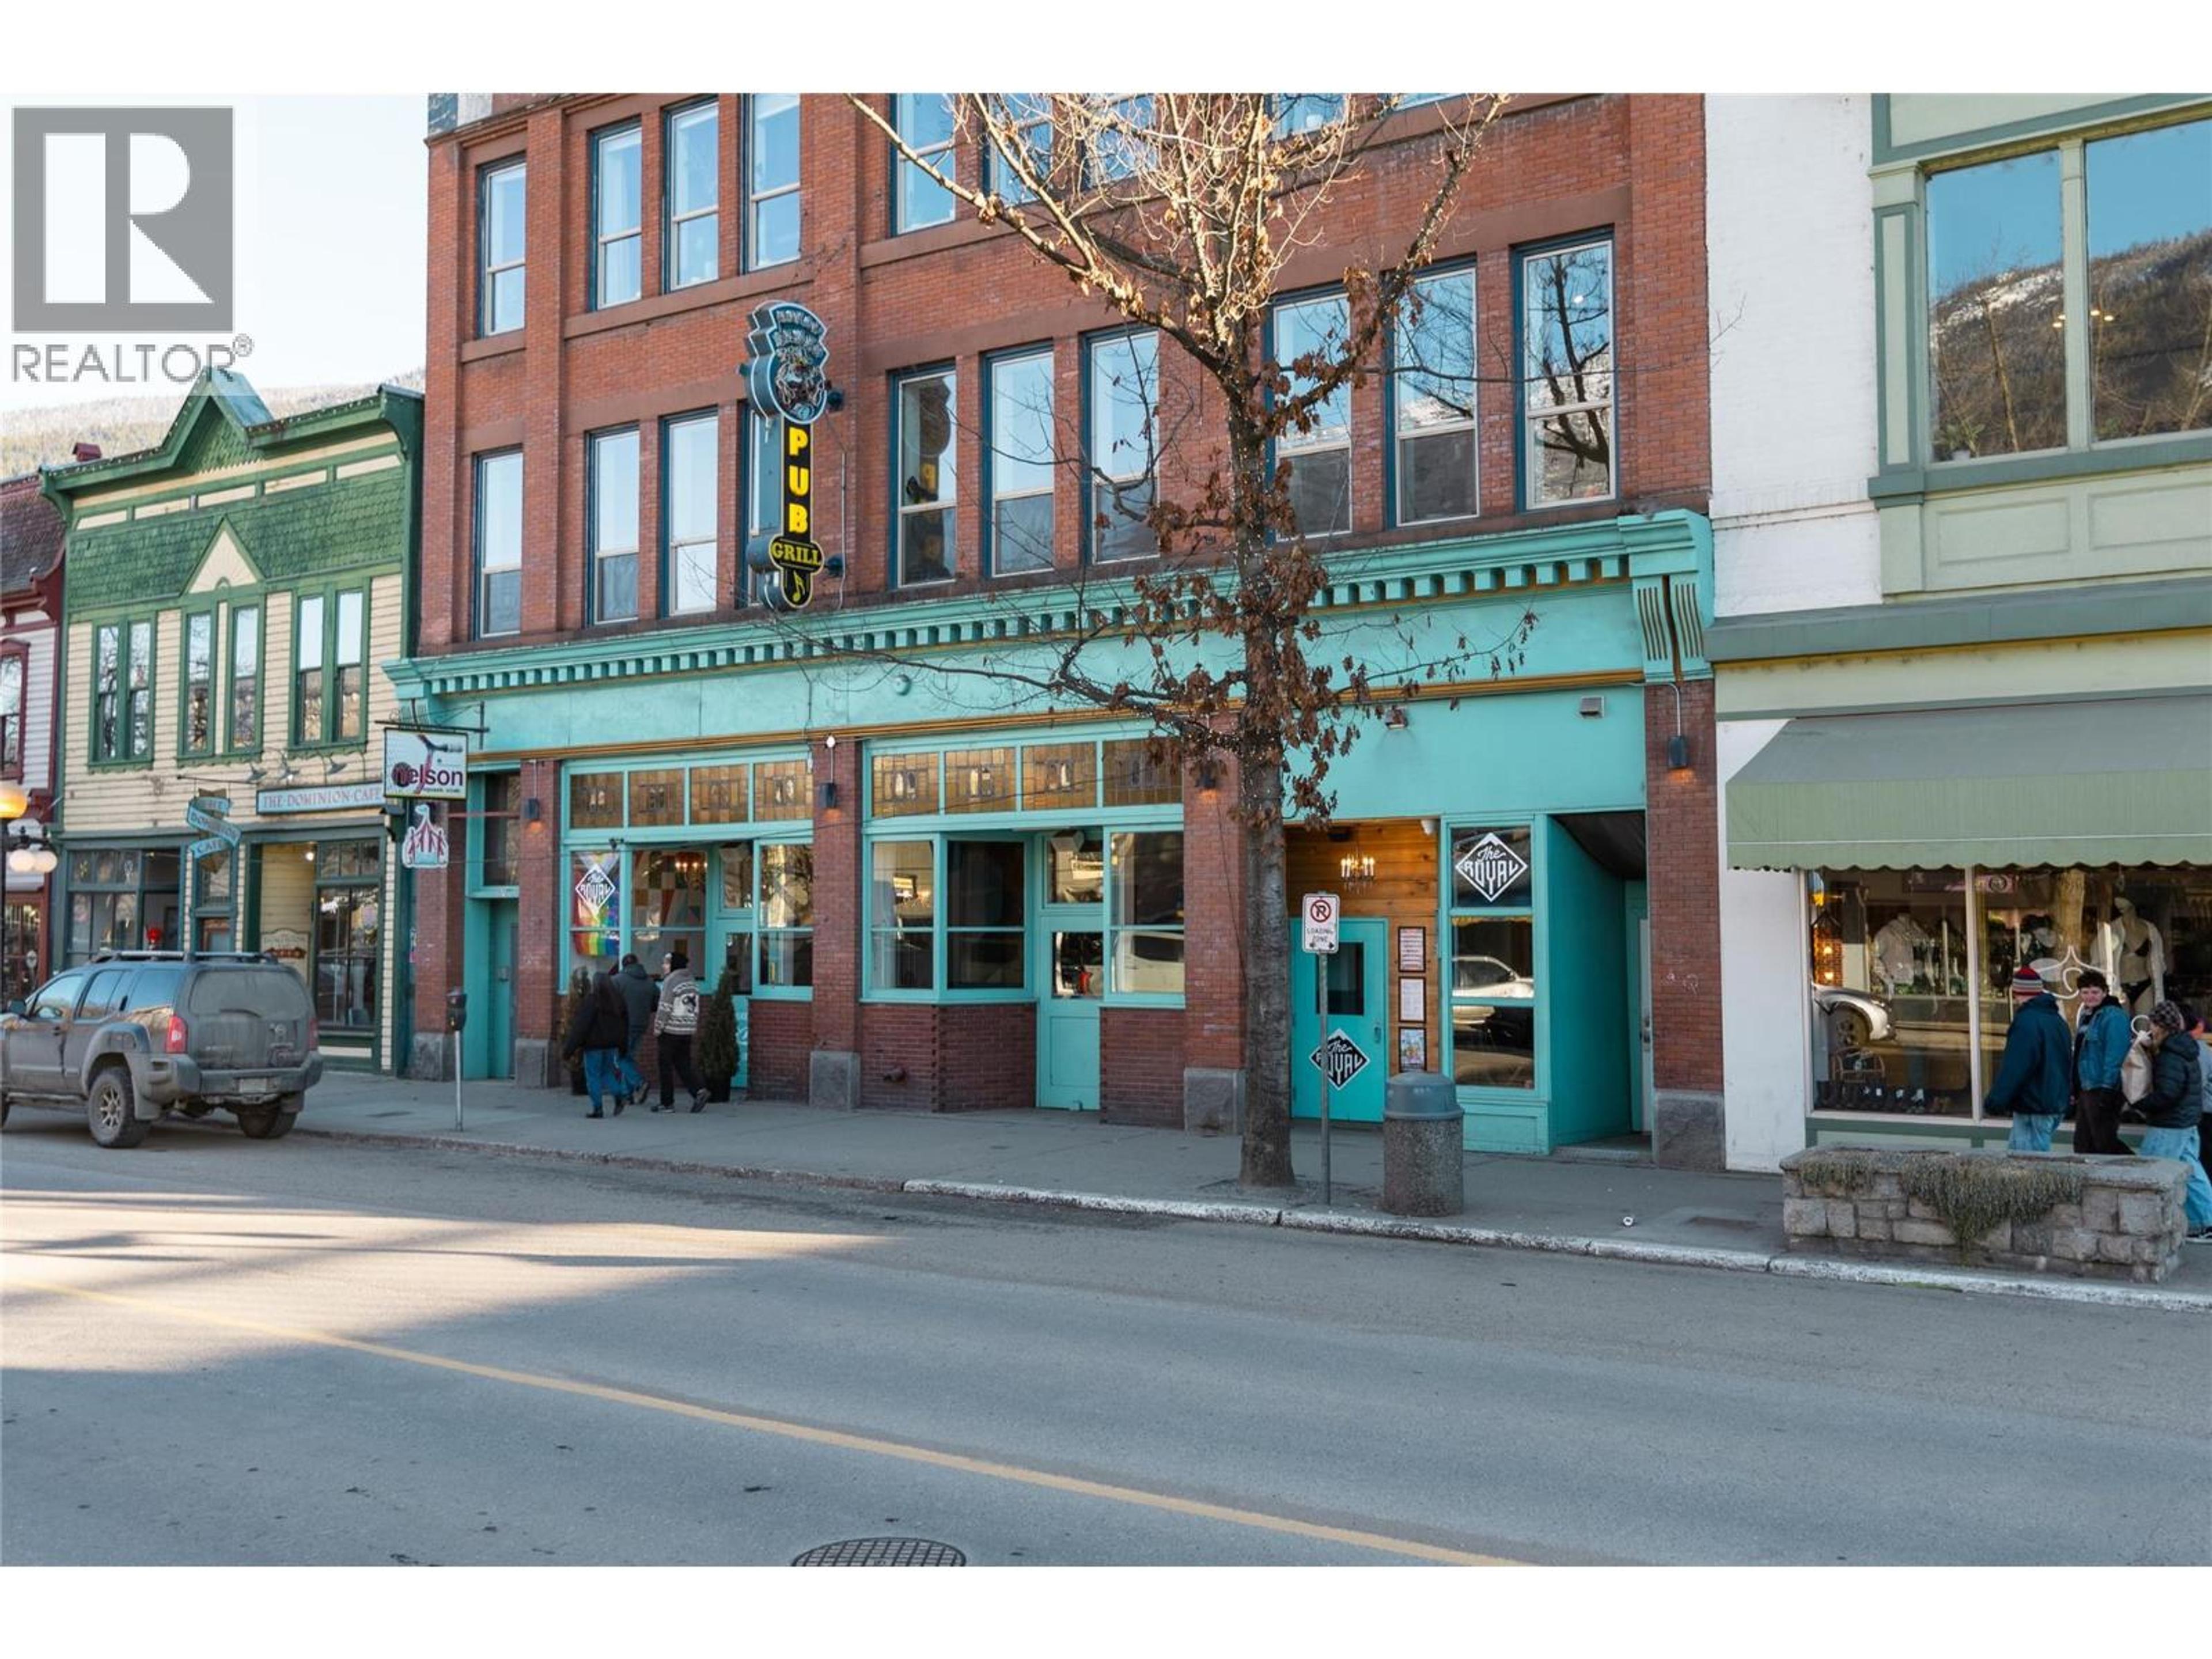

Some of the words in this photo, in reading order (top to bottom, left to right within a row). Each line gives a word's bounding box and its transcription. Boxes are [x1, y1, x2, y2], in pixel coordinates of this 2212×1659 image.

[789, 427, 809, 533] PUB
[771, 542, 820, 566] GRILL
[264, 795, 282, 808] THE
[288, 790, 347, 806] DOMINION
[1476, 845, 1506, 862] The
[1463, 859, 1519, 895] ROYAL
